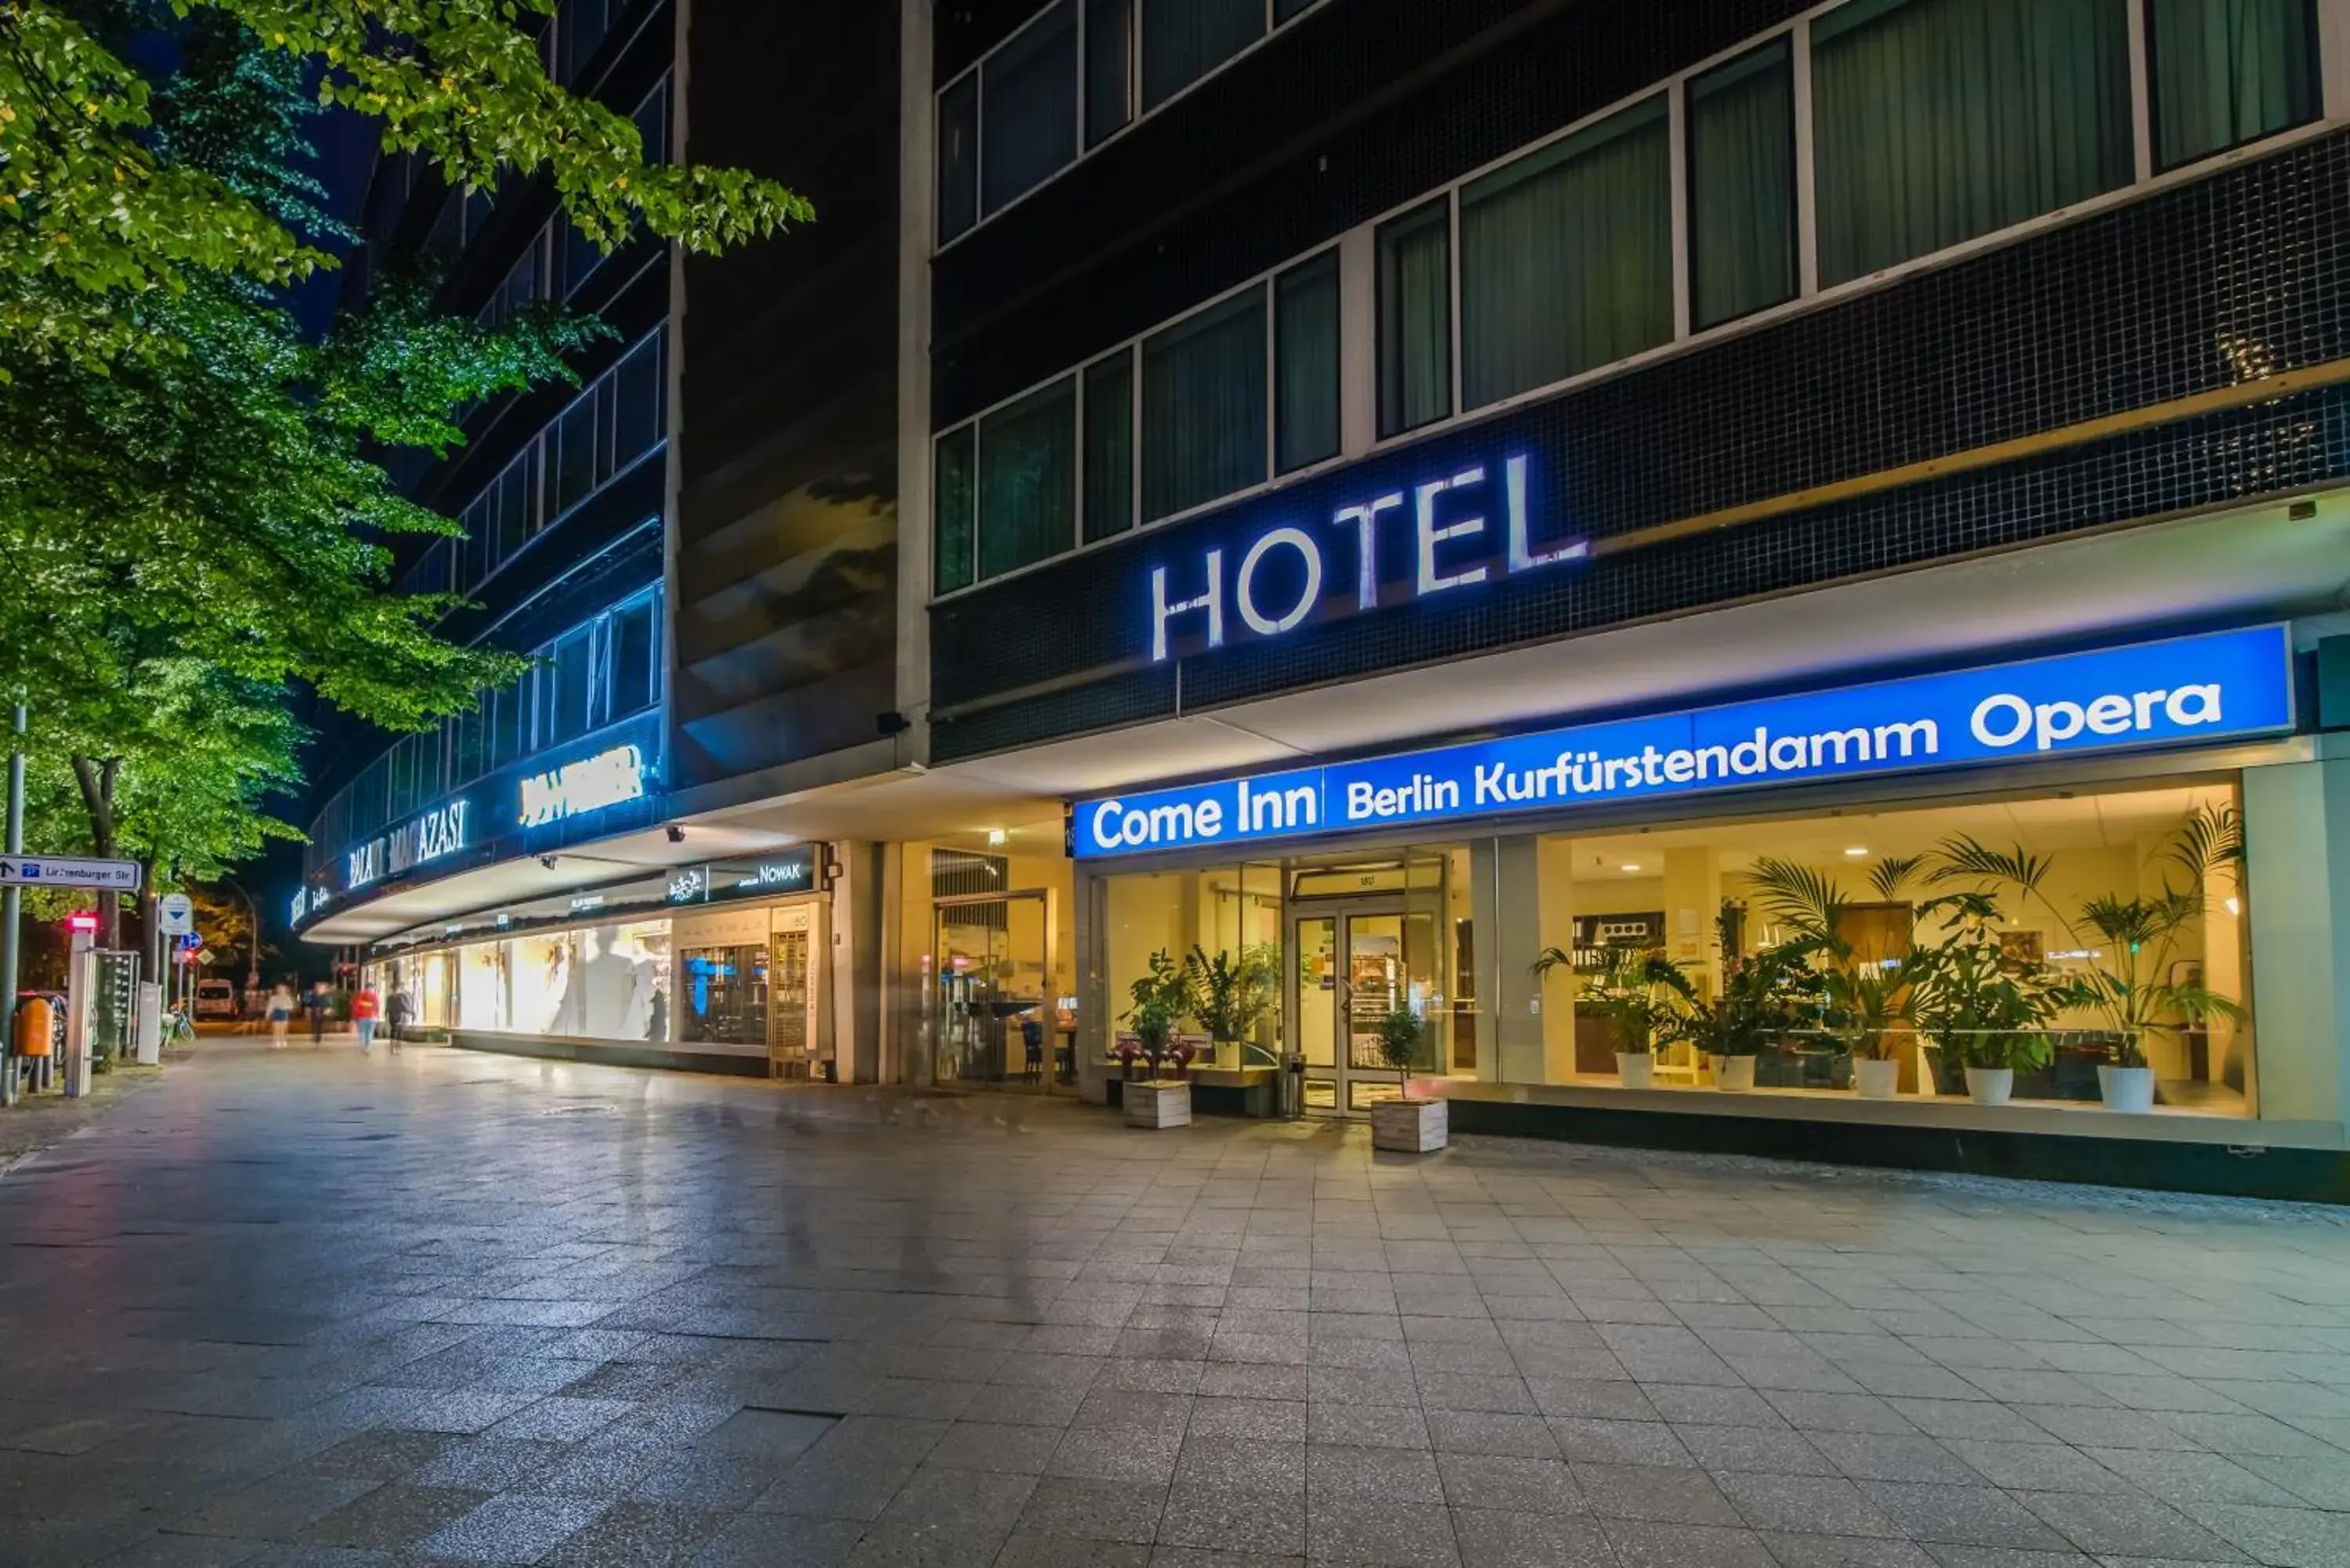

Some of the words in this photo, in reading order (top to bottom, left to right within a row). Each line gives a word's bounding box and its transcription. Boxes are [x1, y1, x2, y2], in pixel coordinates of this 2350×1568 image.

[1152, 453, 1589, 663] HOTEL
[1092, 800, 1223, 850] Come
[1237, 782, 1318, 833] Inn
[1347, 779, 1459, 821] Berlin
[1473, 717, 1939, 804] Kurfürstendamm
[1970, 682, 2222, 750] Opera
[759, 864, 801, 883] NOWAK
